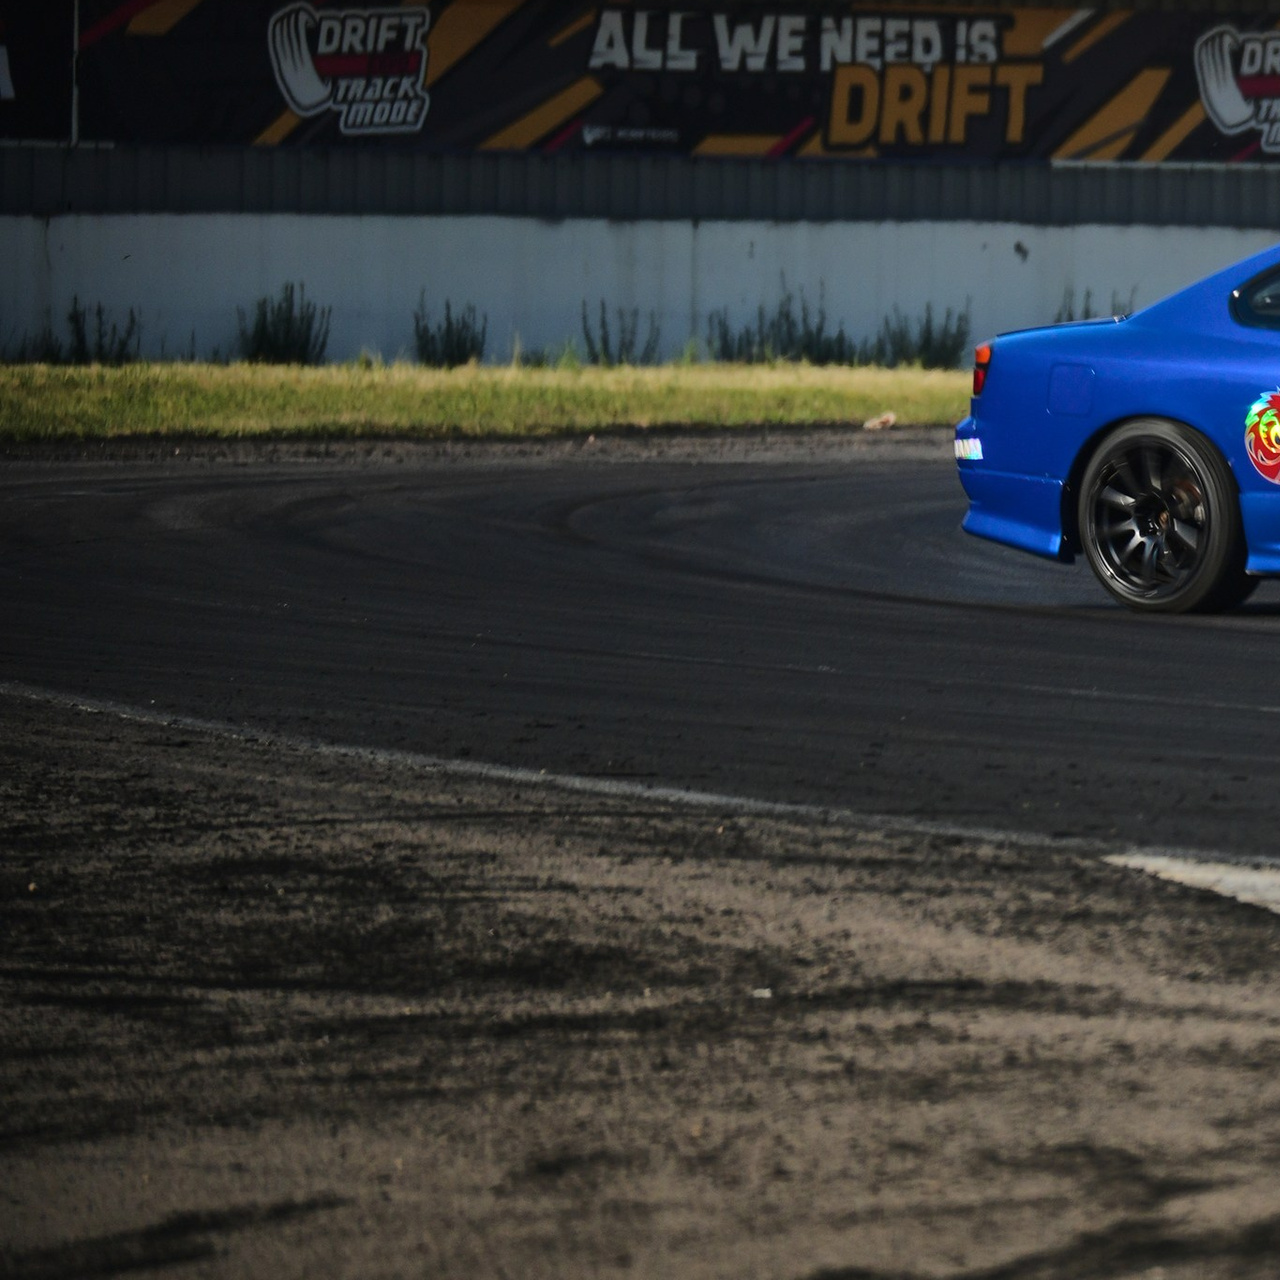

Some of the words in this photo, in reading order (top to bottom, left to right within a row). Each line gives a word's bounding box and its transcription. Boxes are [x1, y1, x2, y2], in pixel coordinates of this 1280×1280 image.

[317, 15, 423, 55] DRIFT
[589, 10, 698, 71] ALL
[713, 13, 806, 72] WE
[820, 16, 943, 73] NEED
[956, 19, 999, 65] IS
[335, 76, 417, 102] TRACK
[827, 62, 1044, 146] DRIFT
[346, 100, 422, 127] MODE
